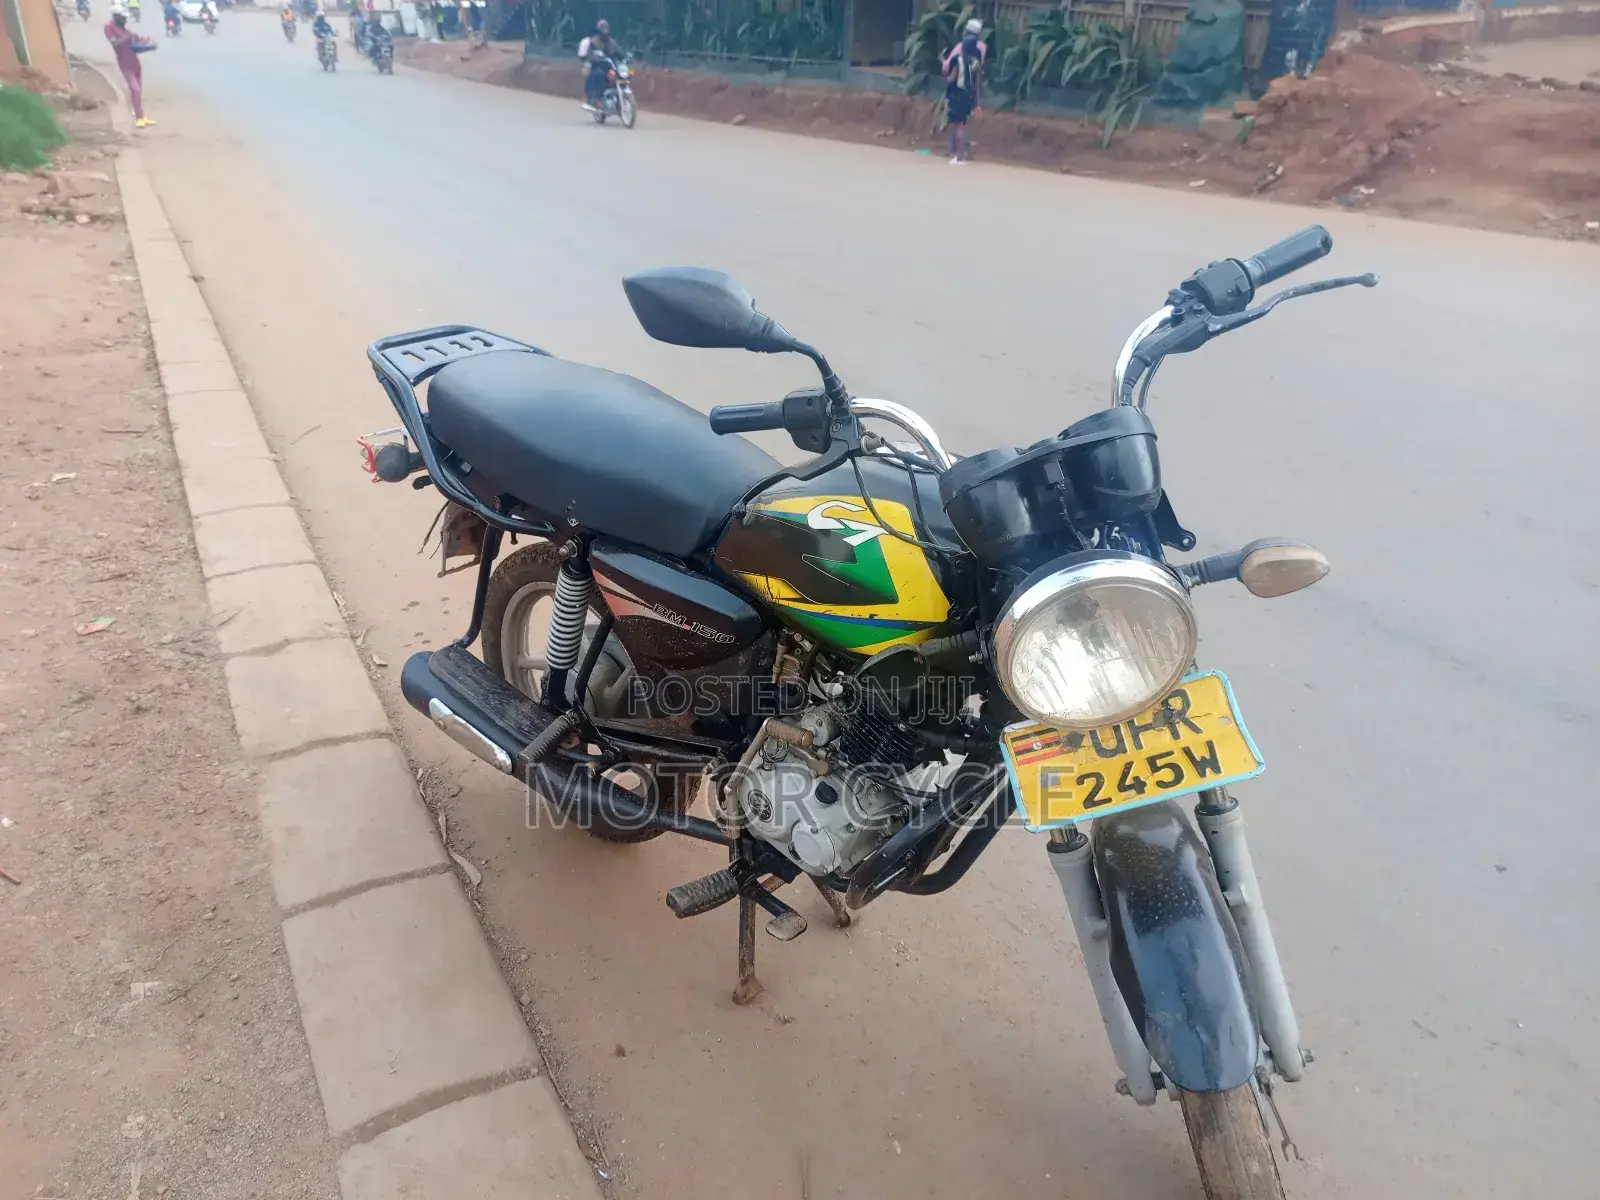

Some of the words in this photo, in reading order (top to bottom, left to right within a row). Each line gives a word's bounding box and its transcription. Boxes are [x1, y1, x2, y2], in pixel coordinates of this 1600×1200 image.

[652, 603, 687, 628] BM
[690, 621, 735, 644] 150
[1076, 739, 1222, 810] 245W
